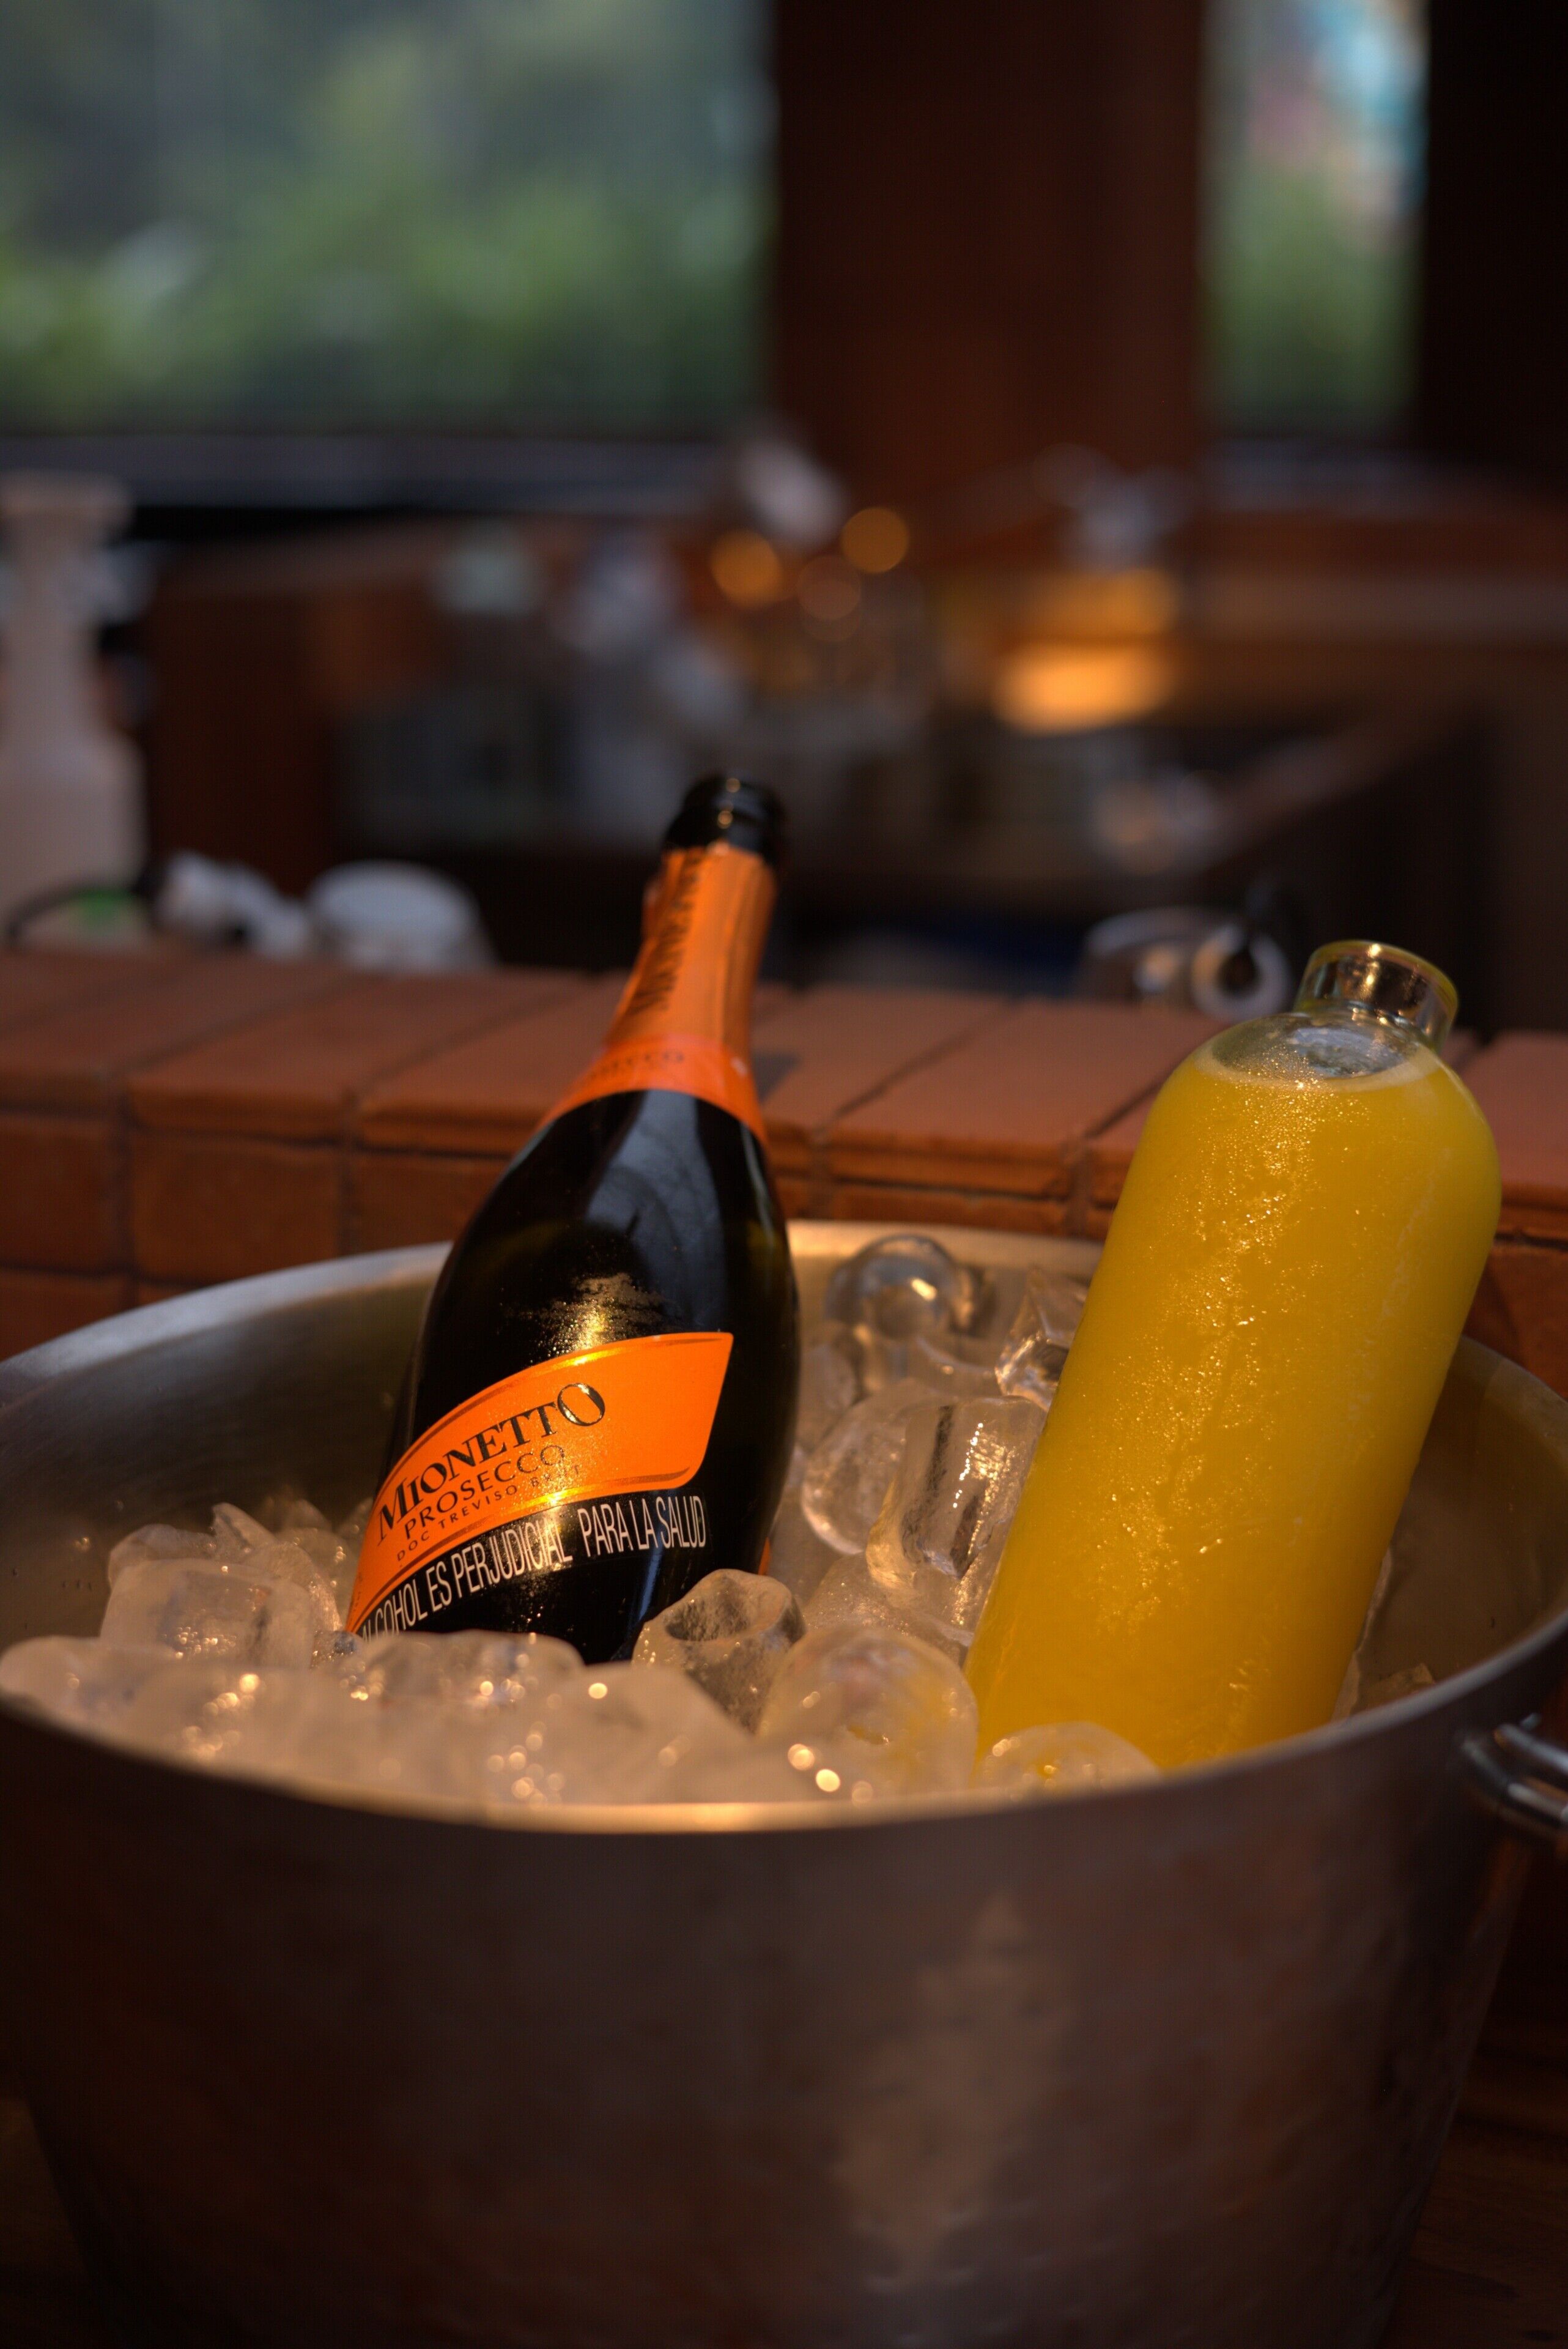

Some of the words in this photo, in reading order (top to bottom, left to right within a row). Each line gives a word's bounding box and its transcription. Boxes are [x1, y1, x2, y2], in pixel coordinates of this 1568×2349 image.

[377, 1382, 605, 1546] MIONETTO
[404, 1445, 565, 1539] PROSECCO
[397, 1531, 429, 1561] DOC
[438, 1485, 517, 1529] TREVISO
[426, 1560, 453, 1612] ES
[451, 1517, 573, 1598] PERJUDICIAL
[577, 1502, 634, 1557] PARA
[629, 1498, 659, 1550] LA
[656, 1496, 706, 1548] SALUD
